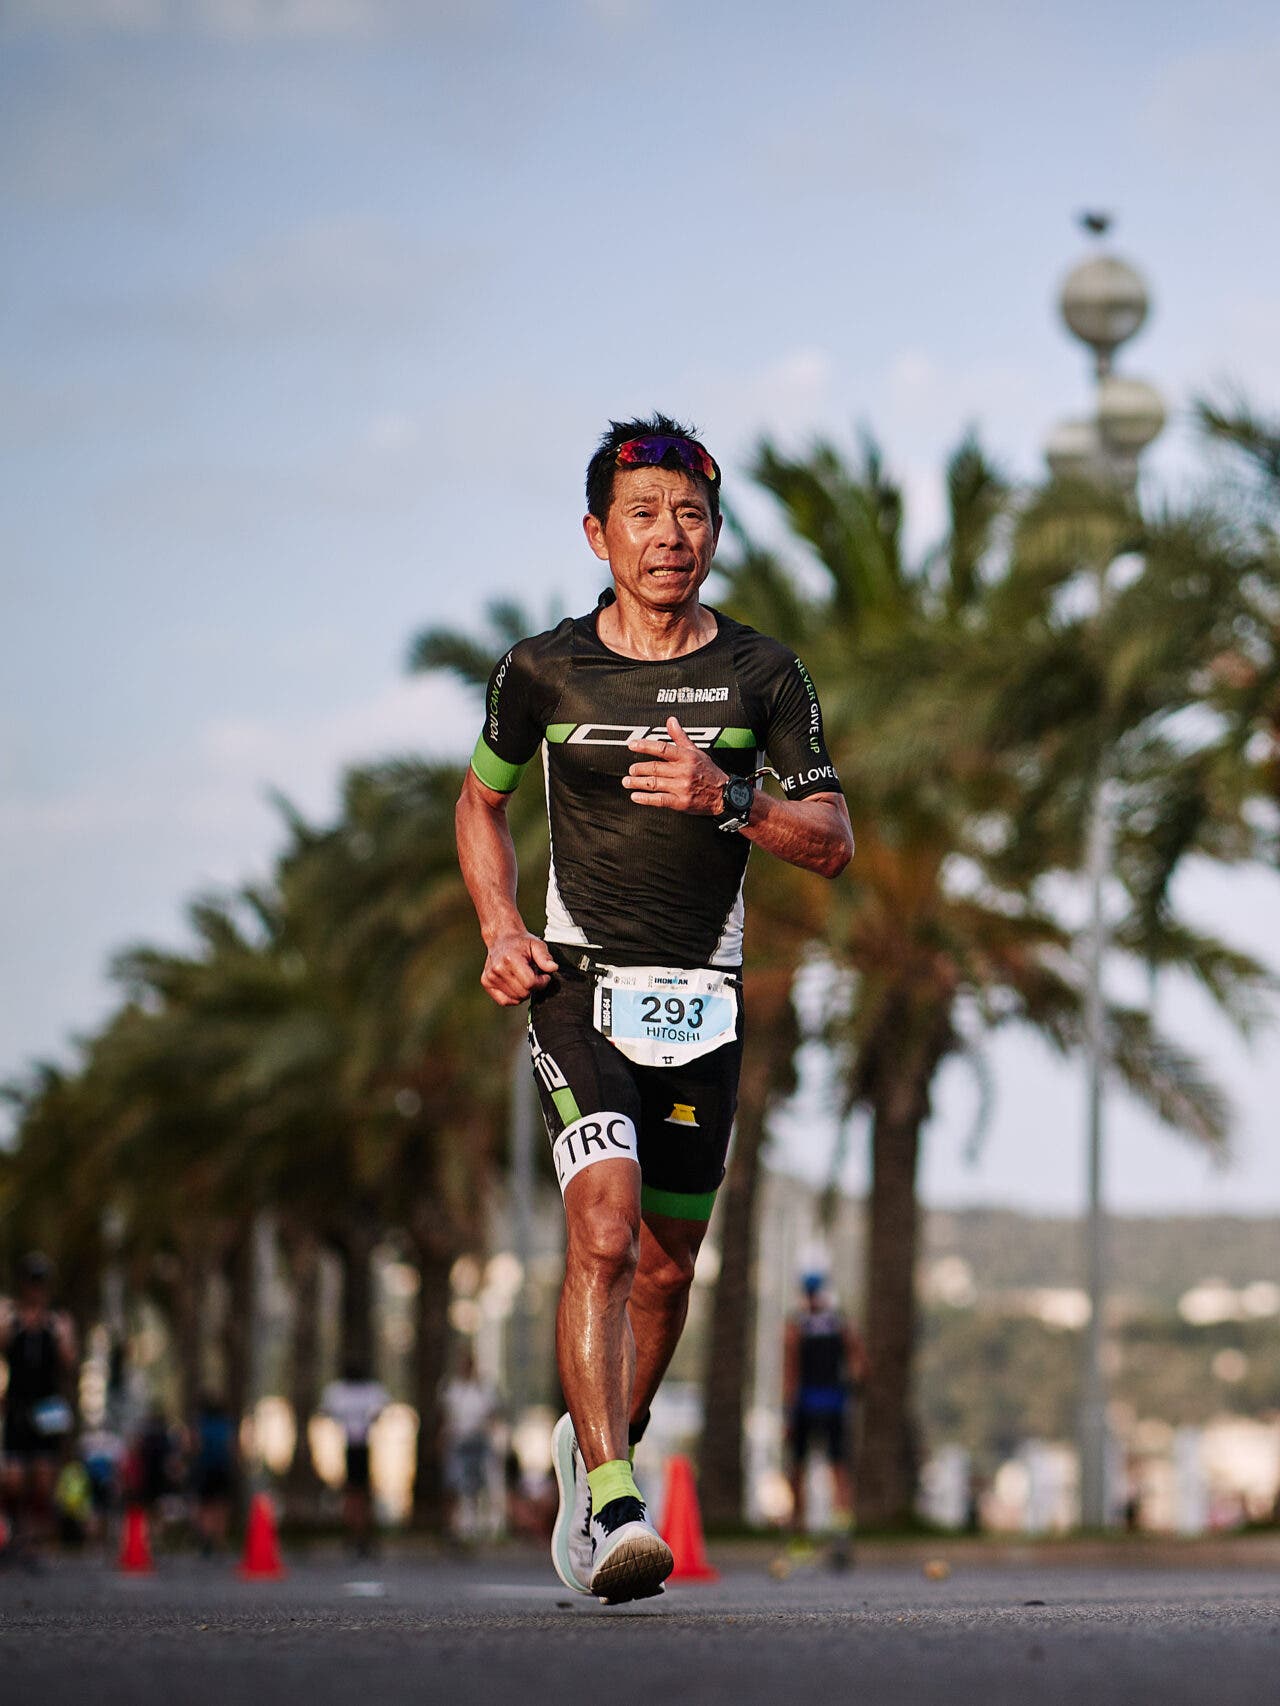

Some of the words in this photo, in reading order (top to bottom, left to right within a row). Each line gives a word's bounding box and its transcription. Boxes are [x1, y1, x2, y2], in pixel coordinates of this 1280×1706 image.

[505, 651, 513, 667] IT
[495, 664, 506, 688] DO
[794, 658, 816, 701] NEVER
[490, 685, 500, 714] CAN
[656, 688, 677, 703] BIO
[694, 687, 729, 703] RACER
[490, 714, 499, 742] YOU
[809, 703, 819, 735] GIVE
[809, 736, 820, 754] UP
[780, 775, 797, 792] WE
[798, 765, 832, 786] LOVE
[640, 996, 704, 1029] 293
[646, 1026, 701, 1042] HITOSHI
